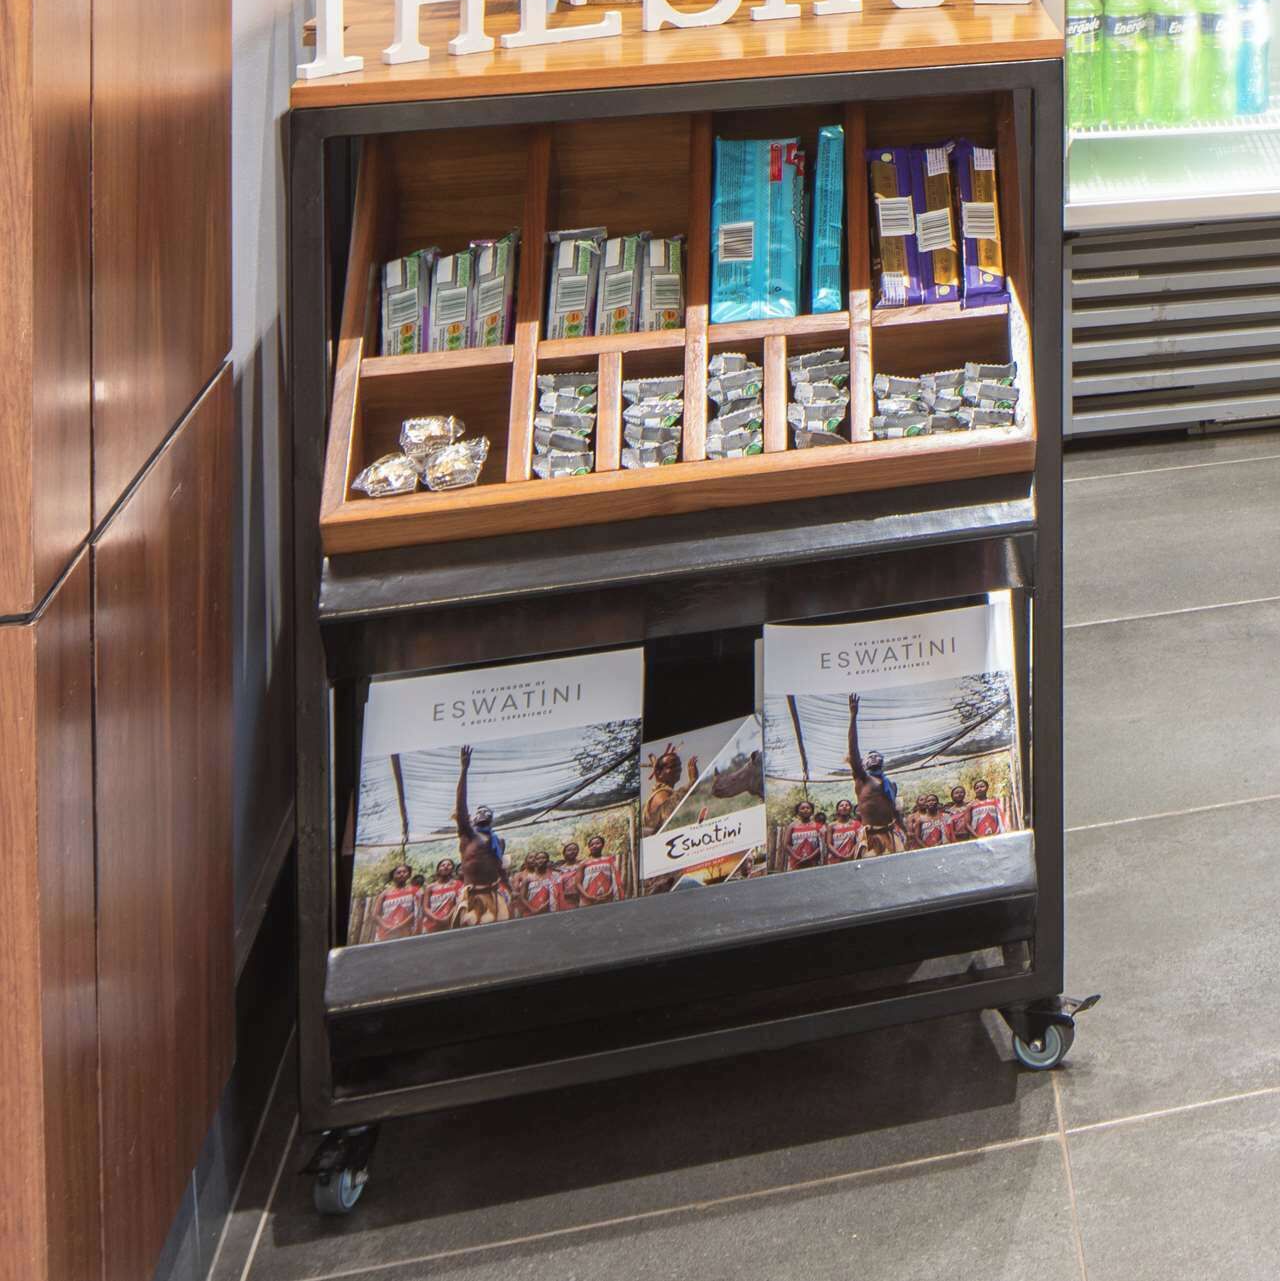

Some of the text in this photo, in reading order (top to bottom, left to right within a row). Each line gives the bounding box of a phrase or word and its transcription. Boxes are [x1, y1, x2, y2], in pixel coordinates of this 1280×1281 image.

[820, 636, 957, 670] ESWATINI
[871, 635, 909, 646] KINGDOM
[433, 683, 582, 721] ESWATINI
[490, 681, 532, 694] KINGDOM
[665, 822, 742, 860] Eswatini
